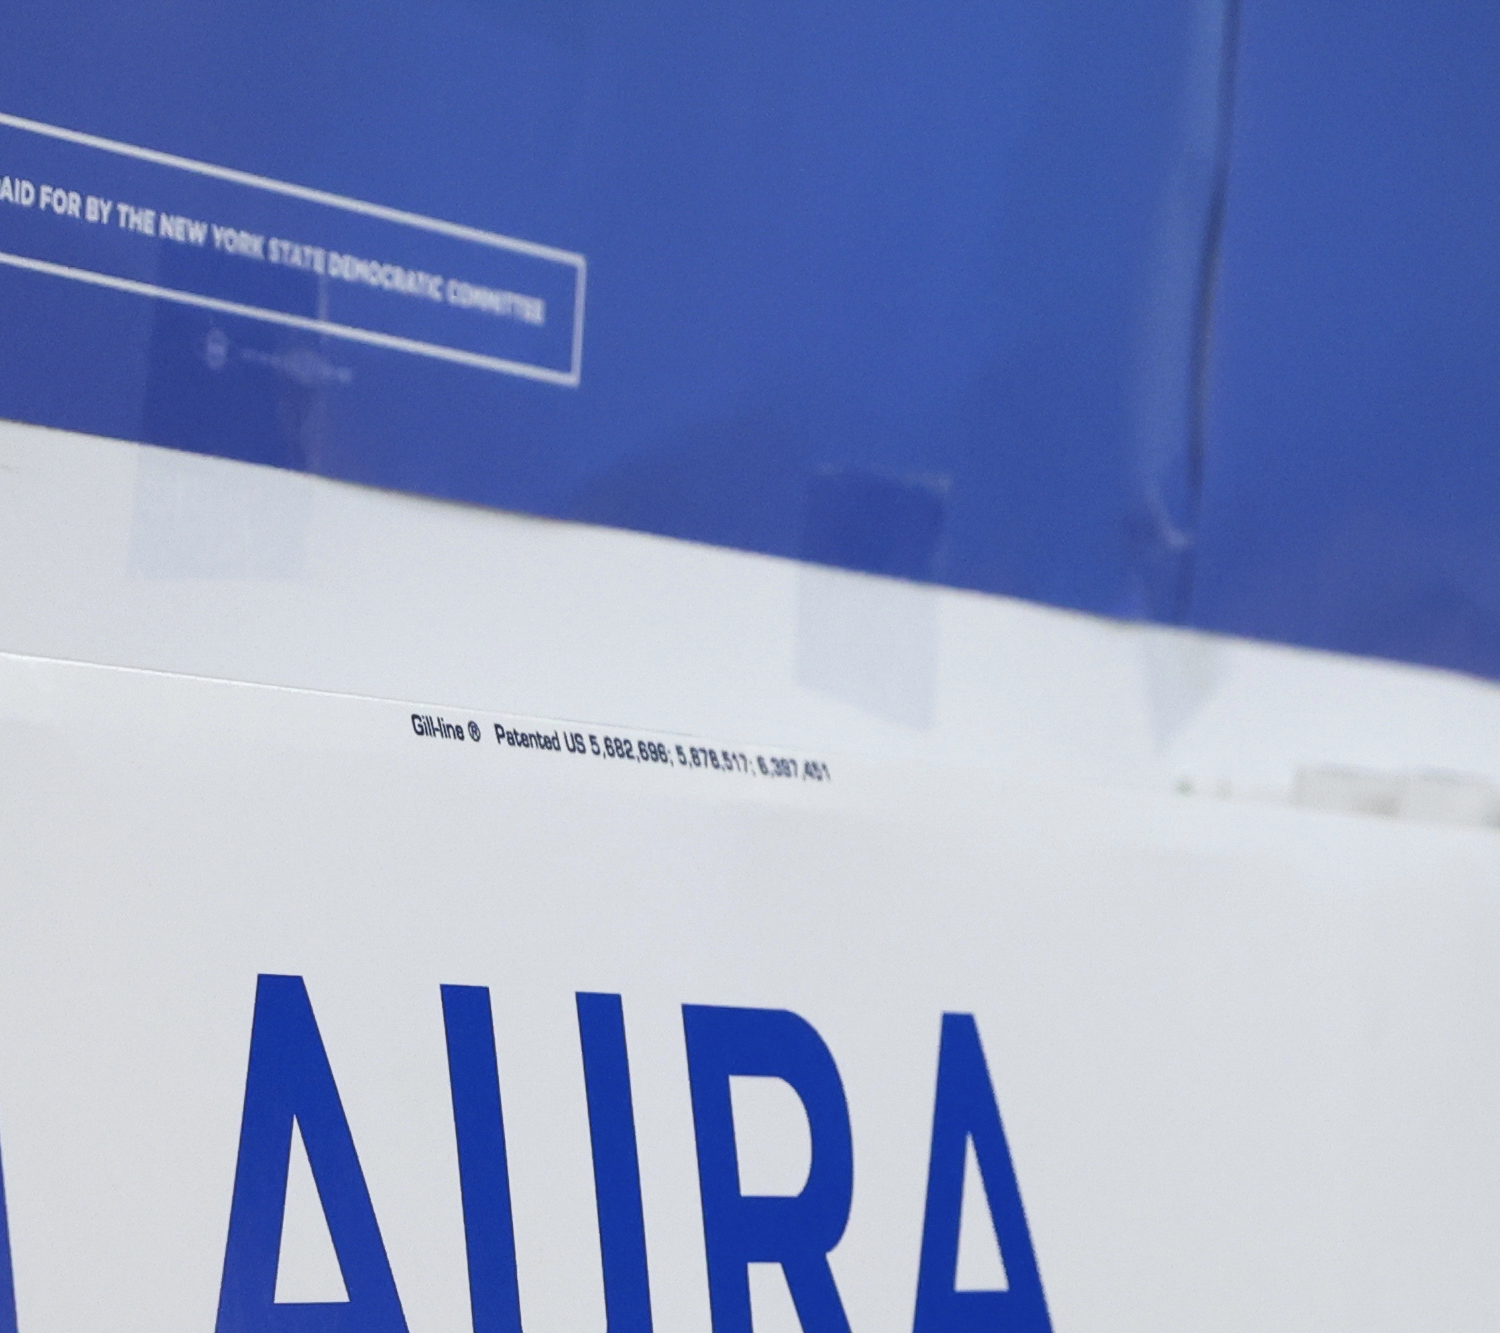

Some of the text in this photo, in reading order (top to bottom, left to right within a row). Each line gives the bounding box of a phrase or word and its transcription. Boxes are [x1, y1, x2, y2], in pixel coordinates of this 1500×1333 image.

[39, 184, 81, 219] FOR
[85, 194, 113, 225] BY
[116, 202, 158, 236] THE
[158, 212, 209, 246] NEW
[211, 222, 267, 261] YORK
[268, 236, 327, 276] STATE
[493, 722, 562, 752] Patented
[563, 730, 587, 755] US
